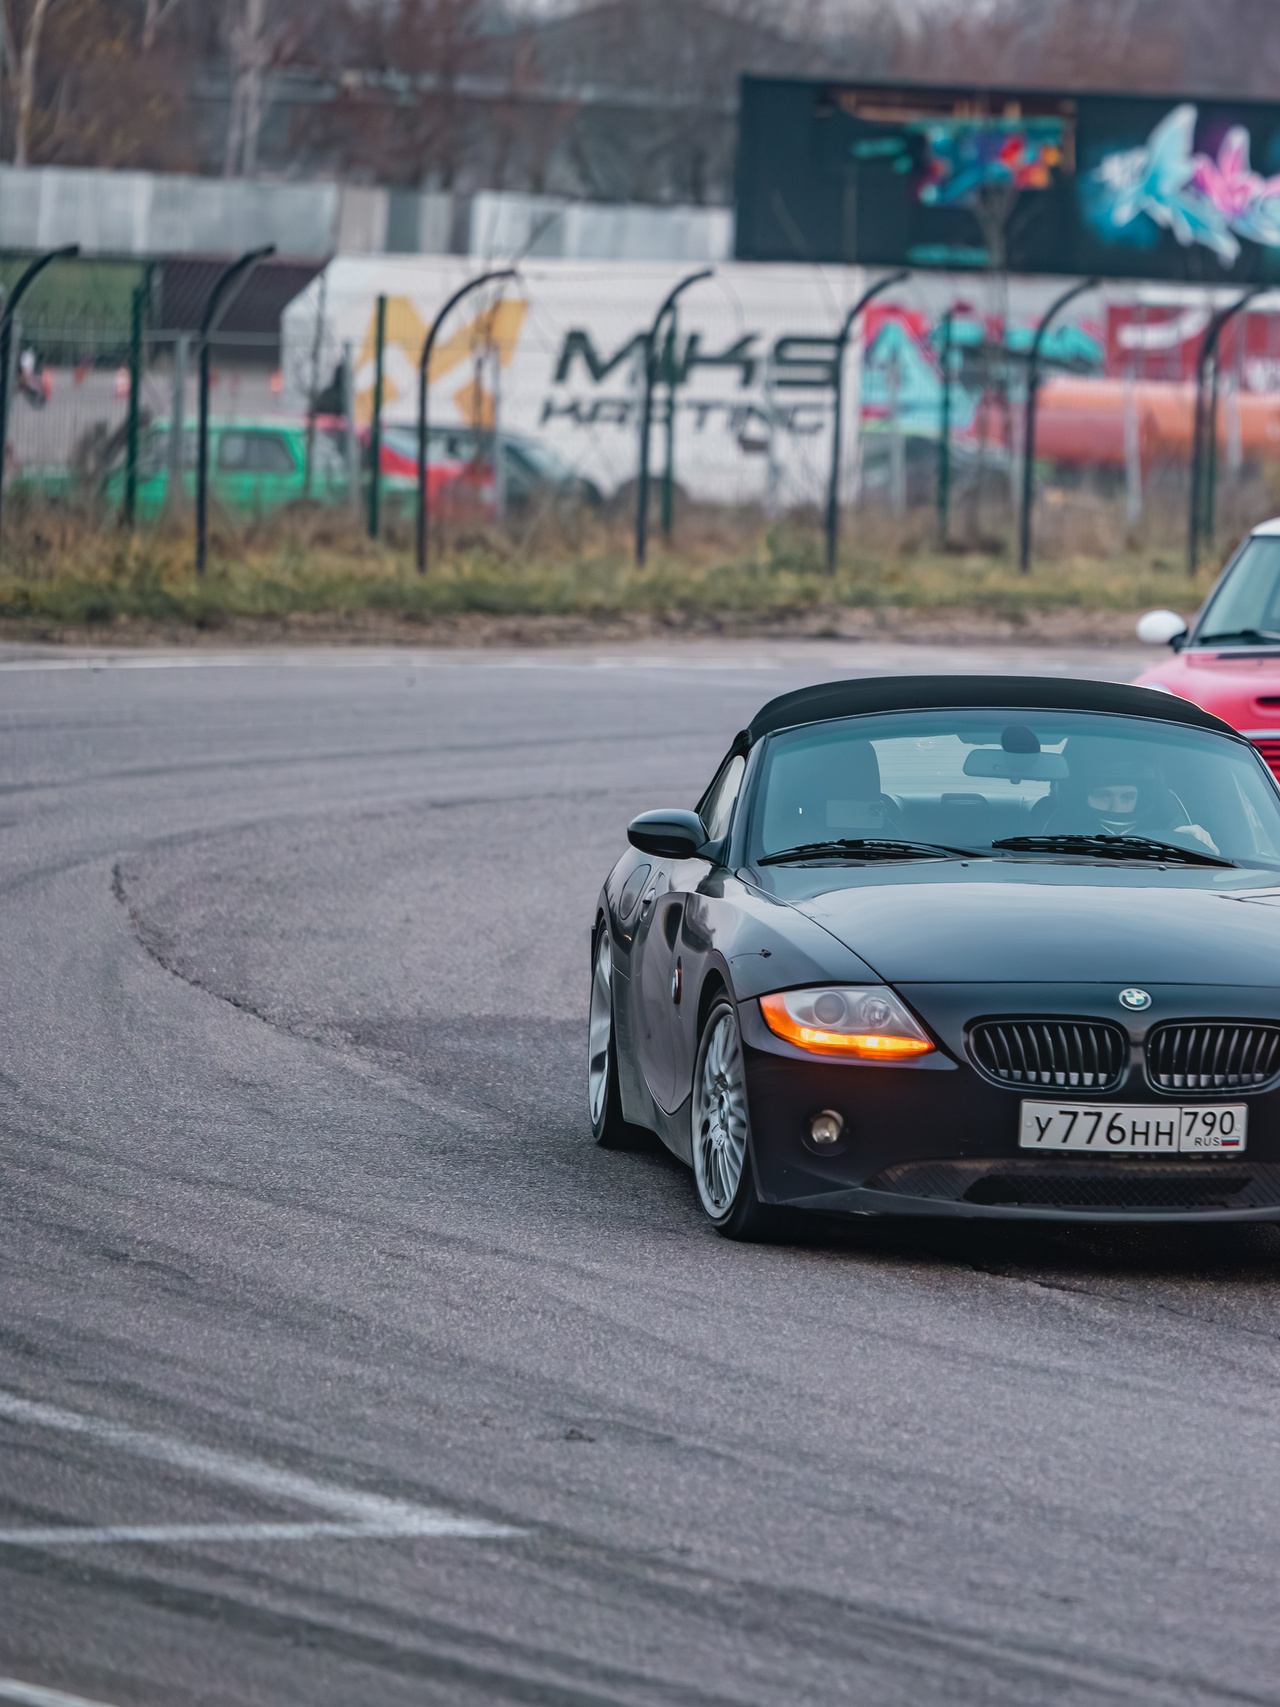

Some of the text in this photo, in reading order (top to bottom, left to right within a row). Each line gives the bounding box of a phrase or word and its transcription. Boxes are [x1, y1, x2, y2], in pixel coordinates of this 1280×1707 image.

[1034, 1110, 1236, 1147] У776НН 790
[1194, 1136, 1220, 1147] RUS
